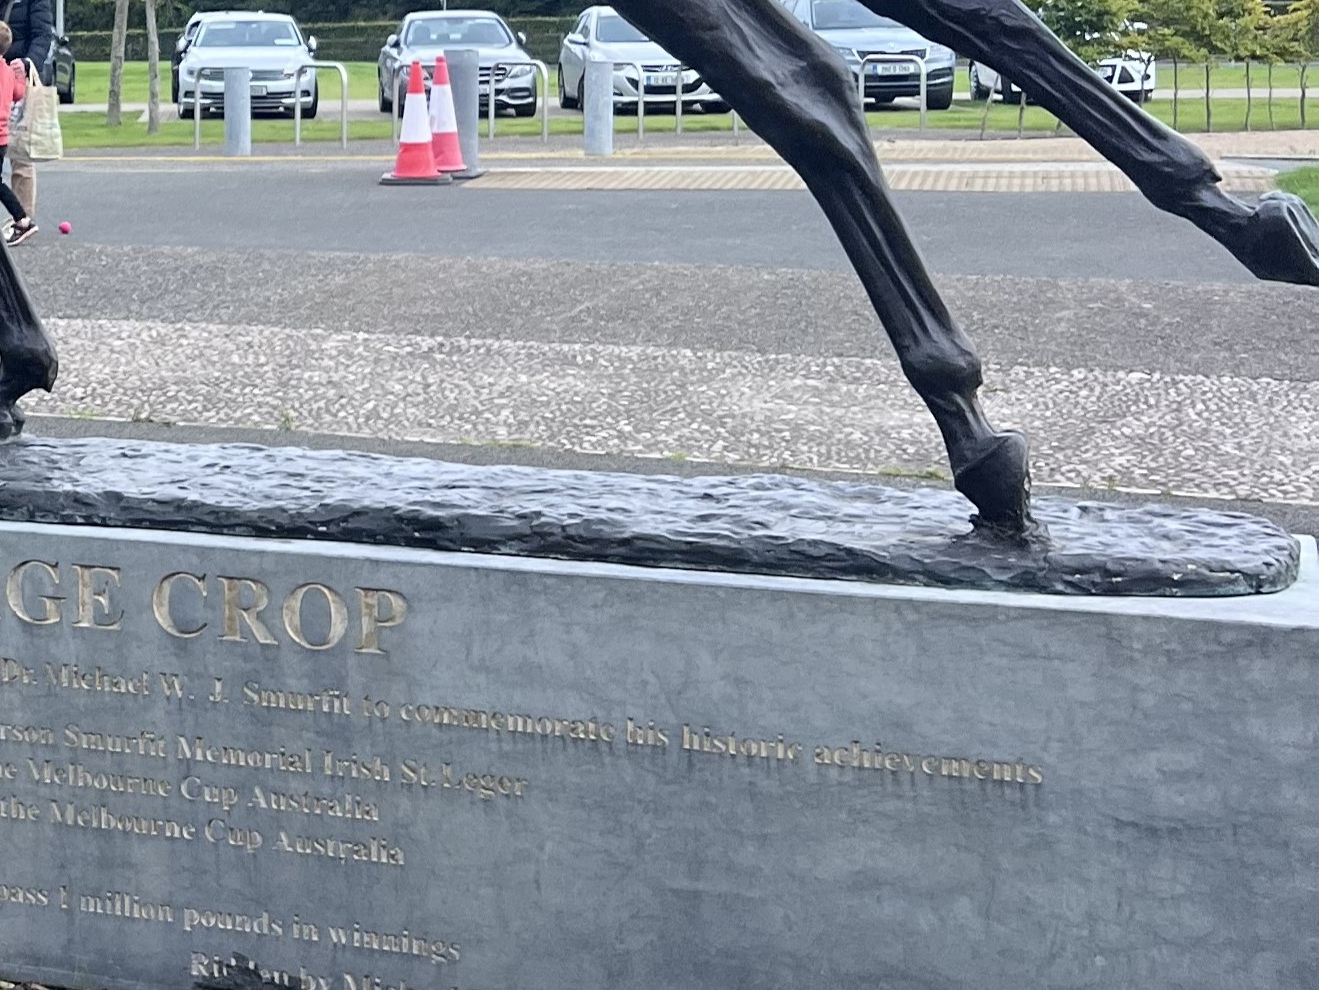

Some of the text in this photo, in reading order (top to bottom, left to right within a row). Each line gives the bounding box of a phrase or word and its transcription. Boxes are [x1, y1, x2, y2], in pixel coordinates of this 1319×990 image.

[152, 570, 409, 655] CROP
[0, 656, 37, 685] Dr.
[44, 661, 151, 696] Michael
[241, 679, 351, 716] Smurfit
[361, 694, 391, 719] to
[399, 702, 615, 744] commemorate
[626, 717, 670, 748] his
[681, 723, 802, 762] historic
[813, 739, 1044, 786] achievements
[63, 722, 167, 759] Smurfit
[176, 734, 313, 775] Memorial
[322, 748, 391, 783] Irish
[25, 757, 172, 799] Melbourne
[180, 774, 239, 811] Cup
[246, 784, 381, 822] Australia
[0, 793, 41, 822] the
[49, 797, 197, 842] Melbourne
[203, 817, 265, 854] Cup
[273, 827, 406, 866] Australia
[59, 884, 70, 910] 1
[80, 890, 175, 924] million
[183, 904, 284, 938] pounds
[291, 913, 320, 942] in
[328, 921, 462, 965] winnings
